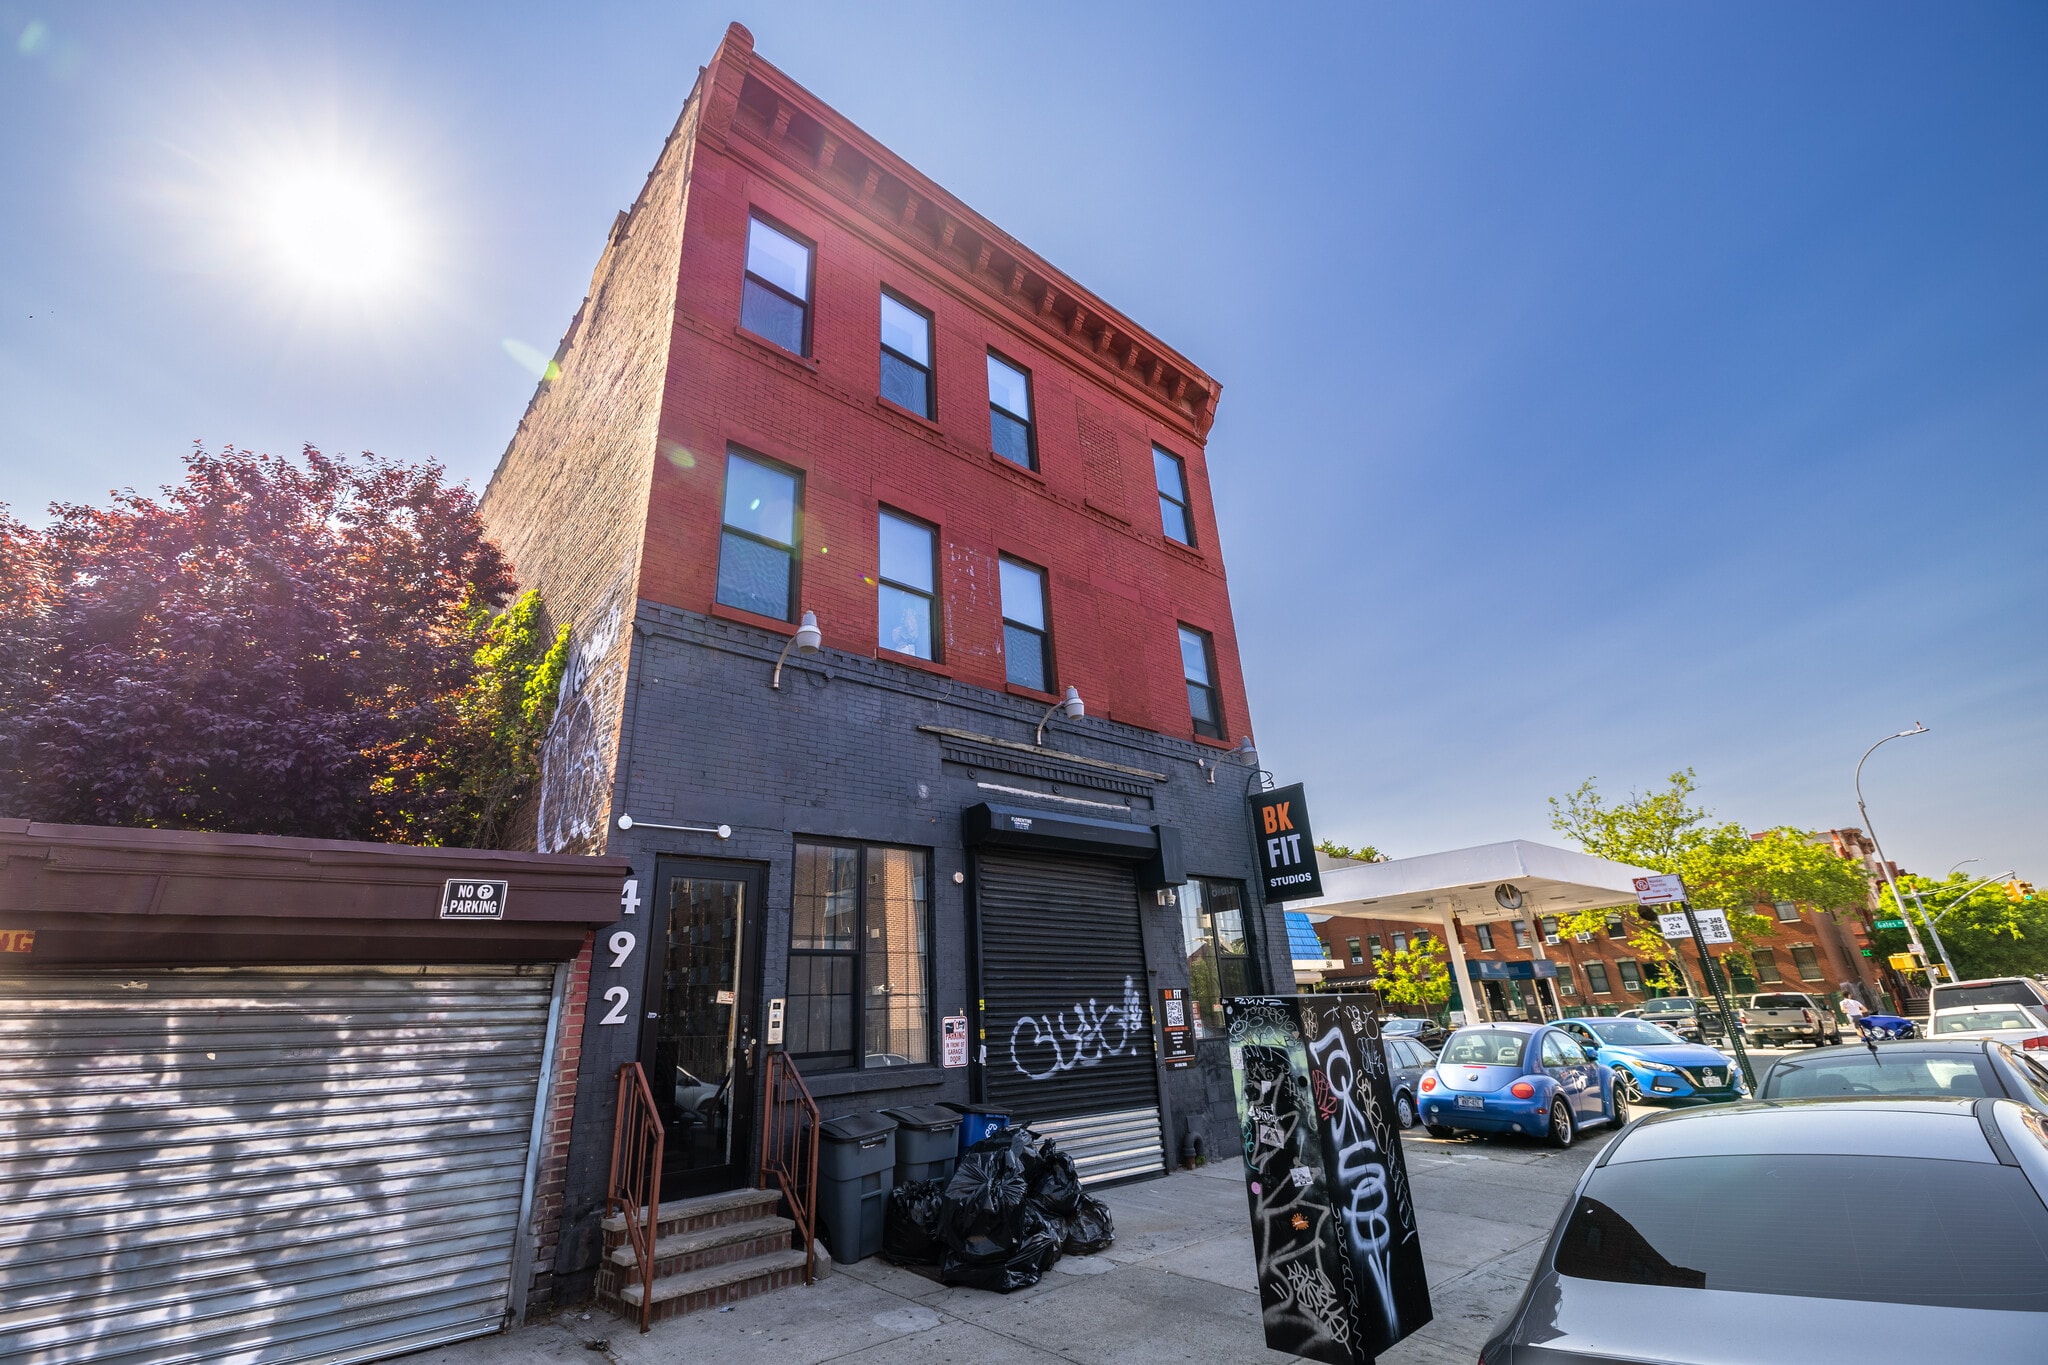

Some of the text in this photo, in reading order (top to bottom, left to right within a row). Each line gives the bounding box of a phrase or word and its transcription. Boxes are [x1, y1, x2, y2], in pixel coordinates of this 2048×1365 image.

[1262, 801, 1294, 834] BK
[1267, 833, 1301, 868] FIT
[1270, 872, 1312, 887] STUDIOS
[458, 884, 474, 898] NO
[449, 900, 497, 913] PARKING
[1164, 989, 1182, 999] BK FIT
